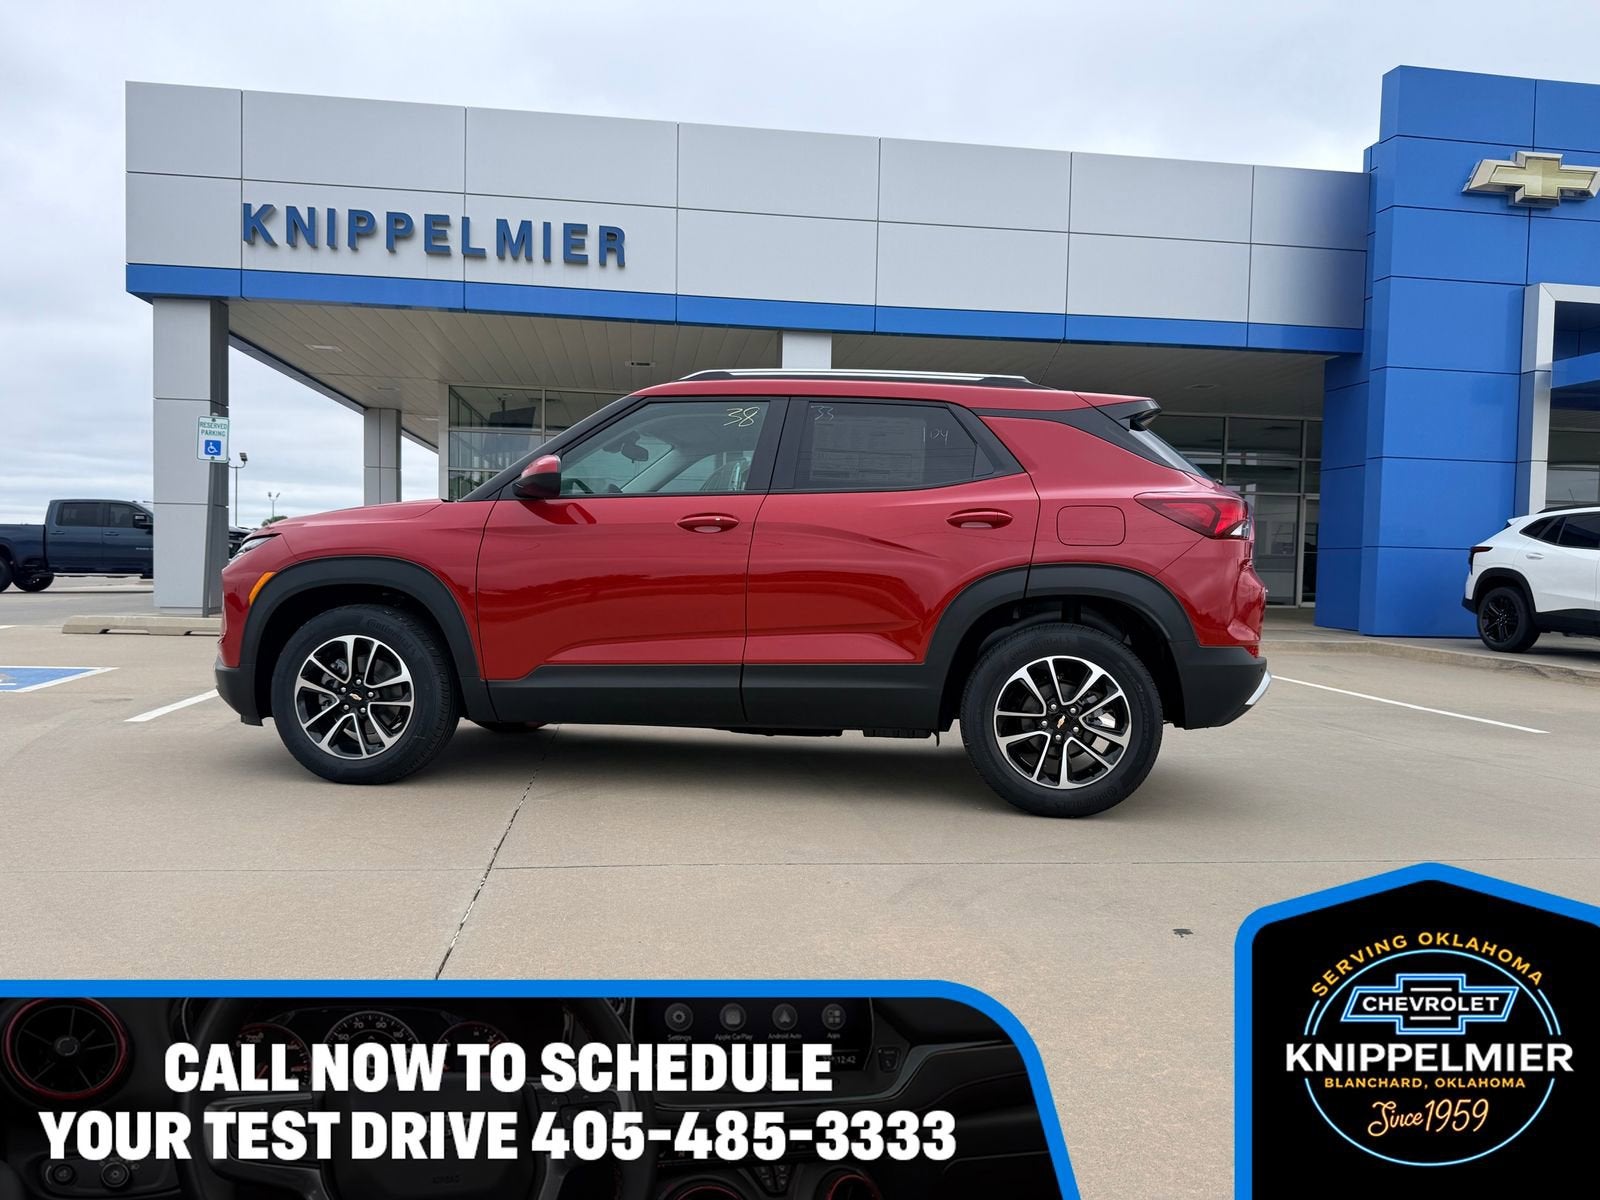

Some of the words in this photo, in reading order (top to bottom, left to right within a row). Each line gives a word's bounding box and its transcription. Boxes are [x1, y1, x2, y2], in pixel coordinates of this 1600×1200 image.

[242, 202, 626, 268] KNIPPELMIER
[724, 406, 760, 428] 38
[200, 421, 228, 430] RESERVED
[201, 429, 226, 437] PARKING
